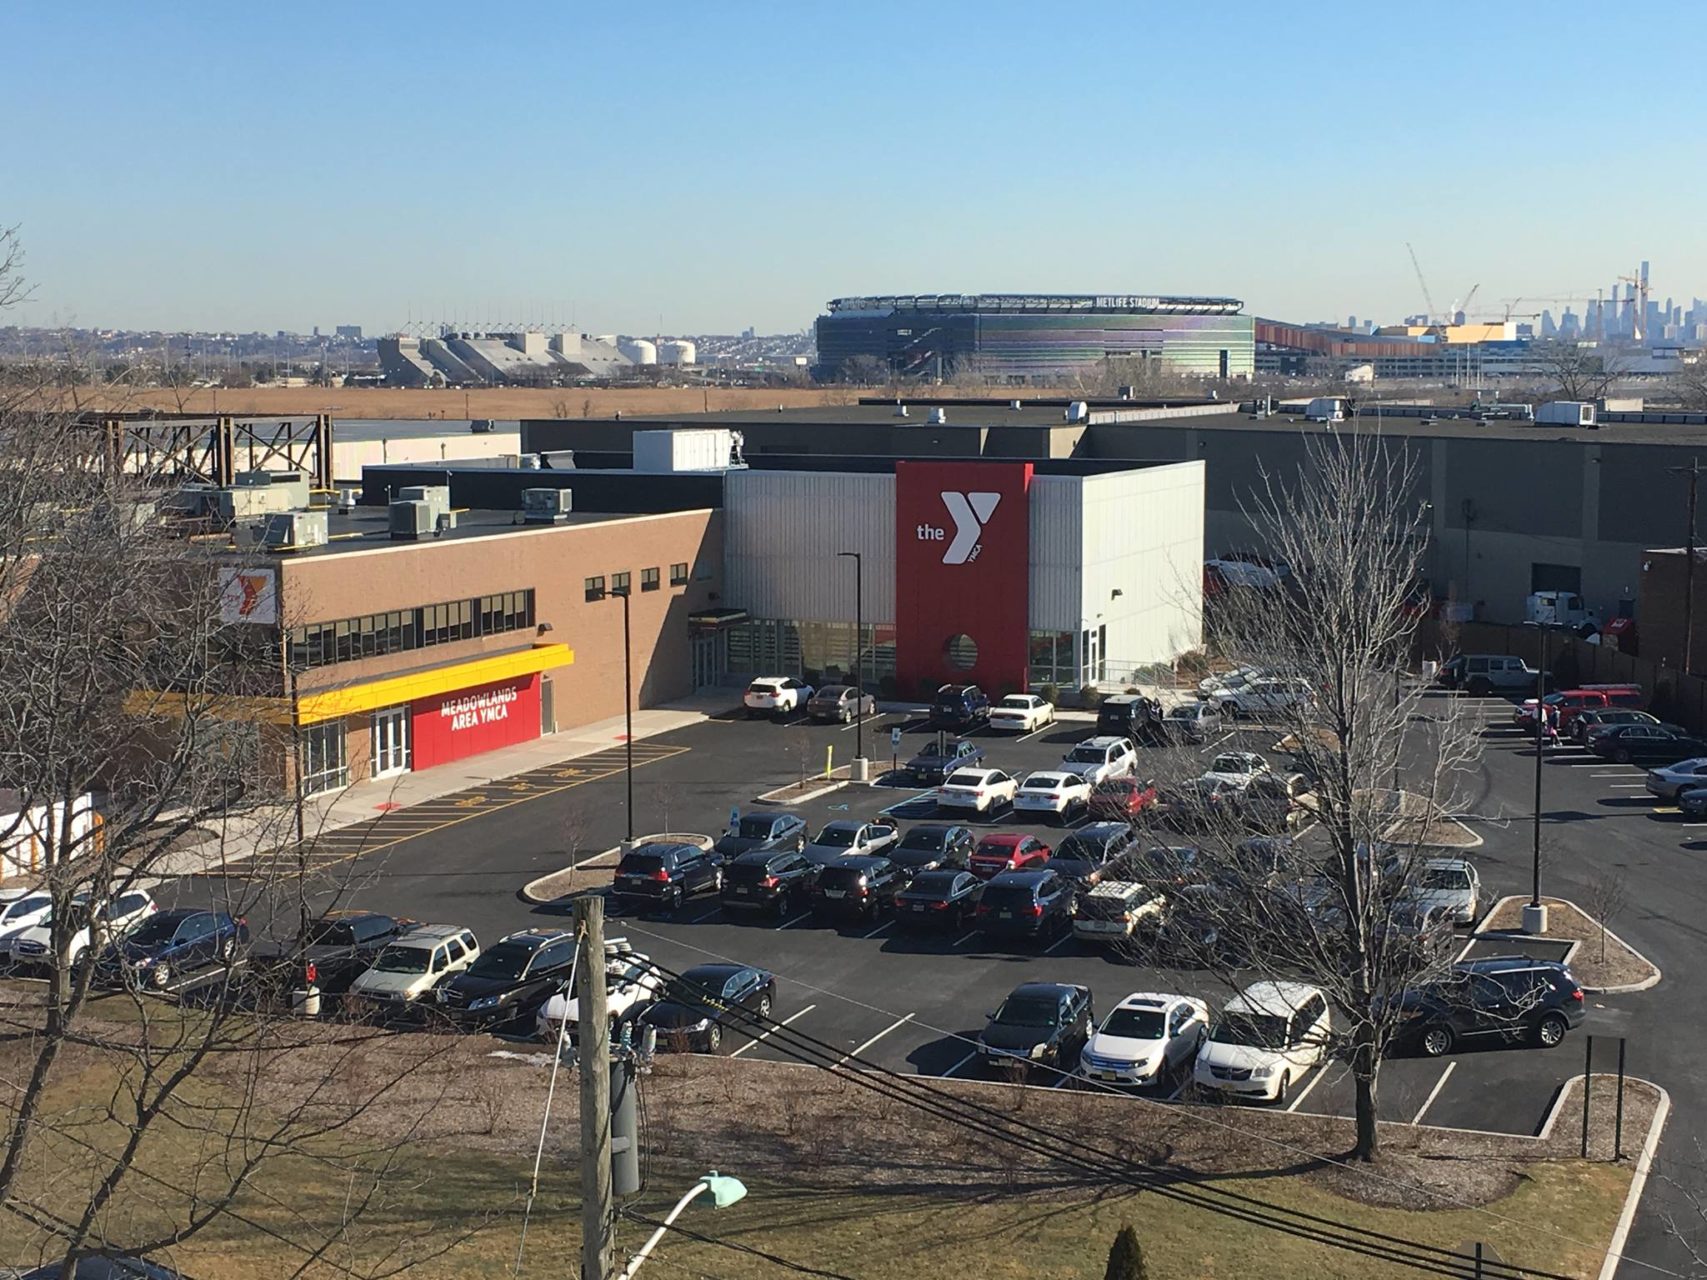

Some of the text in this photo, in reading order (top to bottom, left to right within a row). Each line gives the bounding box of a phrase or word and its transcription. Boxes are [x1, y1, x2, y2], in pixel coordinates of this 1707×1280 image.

[1096, 297, 1160, 309] METLIFE STADIUM
[917, 524, 945, 540] the
[967, 544, 983, 563] YMCA
[441, 686, 517, 718] MEADOWLANDS
[451, 703, 508, 731] AREA YMCA
